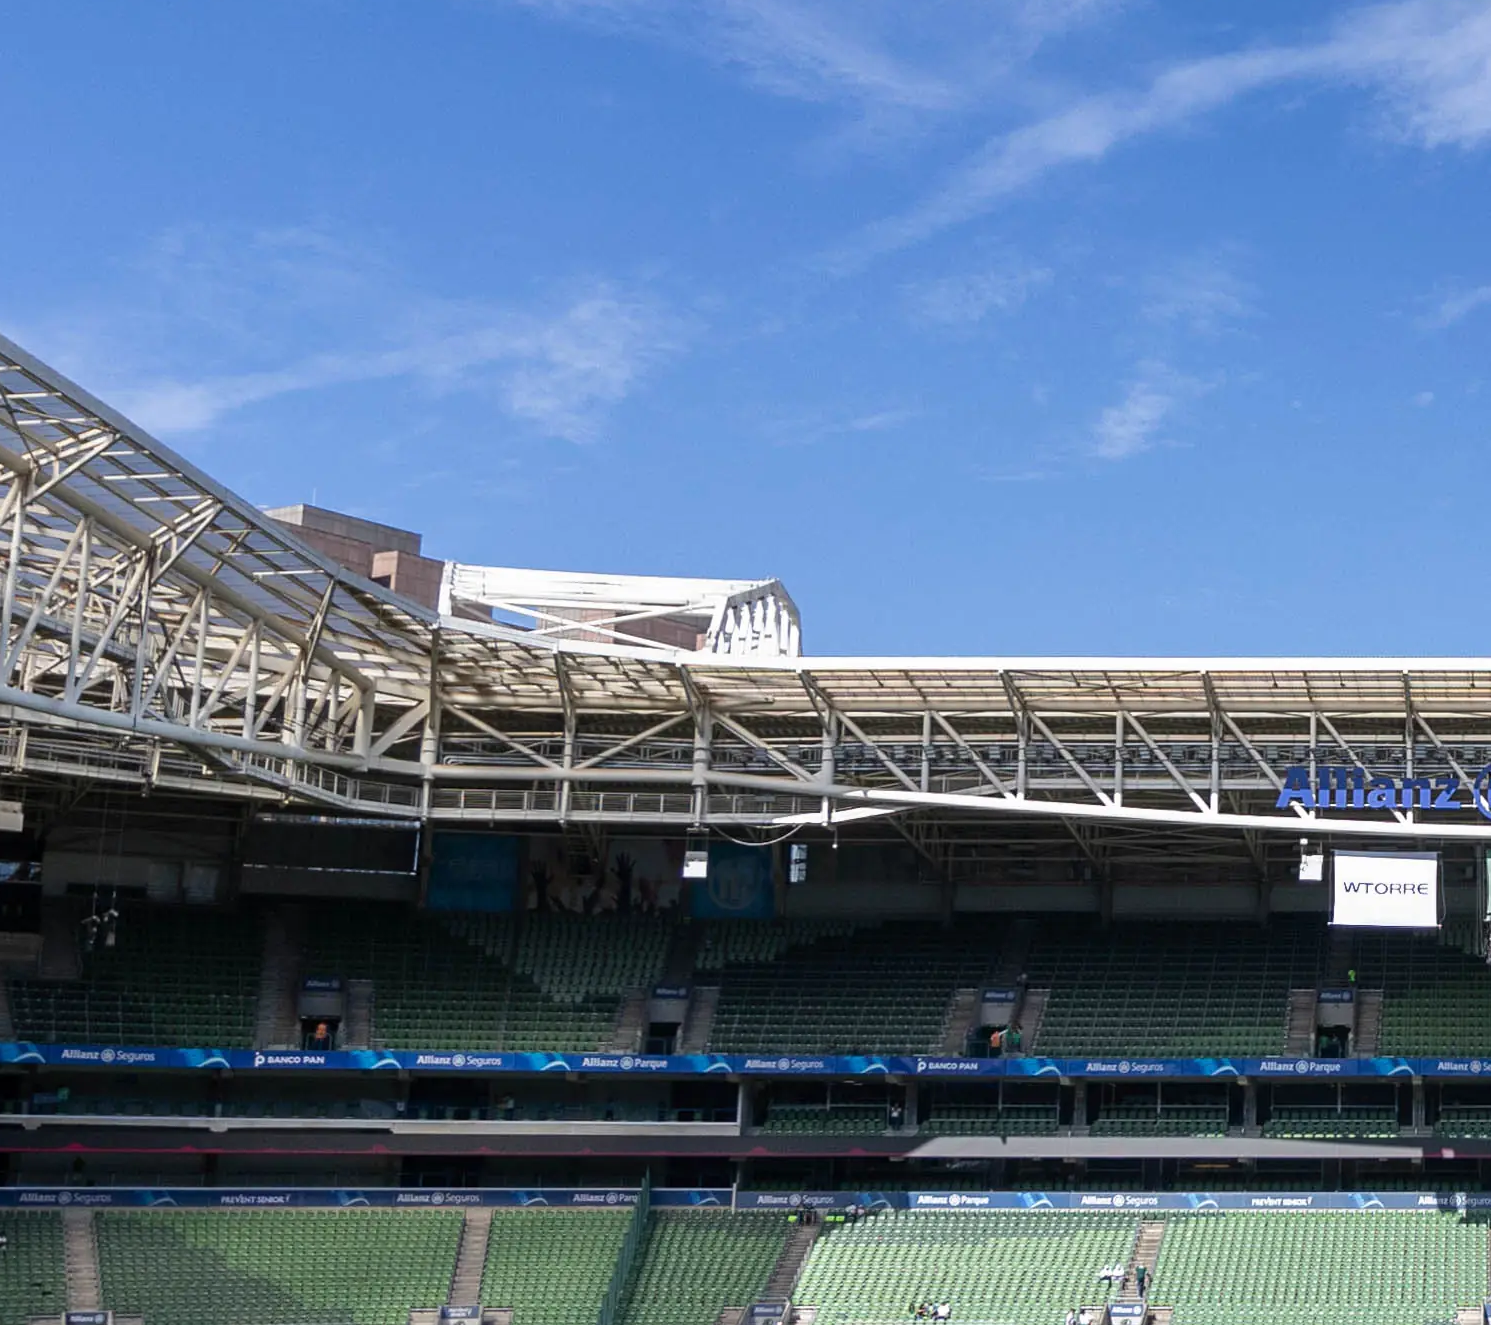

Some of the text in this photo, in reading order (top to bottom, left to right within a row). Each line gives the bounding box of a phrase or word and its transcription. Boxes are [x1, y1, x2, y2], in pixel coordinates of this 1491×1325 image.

[1276, 766, 1462, 810] Allianz
[1342, 880, 1429, 896] WTORRE
[268, 1055, 326, 1065] BANCO PAN
[417, 1055, 502, 1070] Allianz Seguros
[1260, 1061, 1341, 1075] Allianz Parque
[917, 1194, 989, 1208] Allianz Parque
